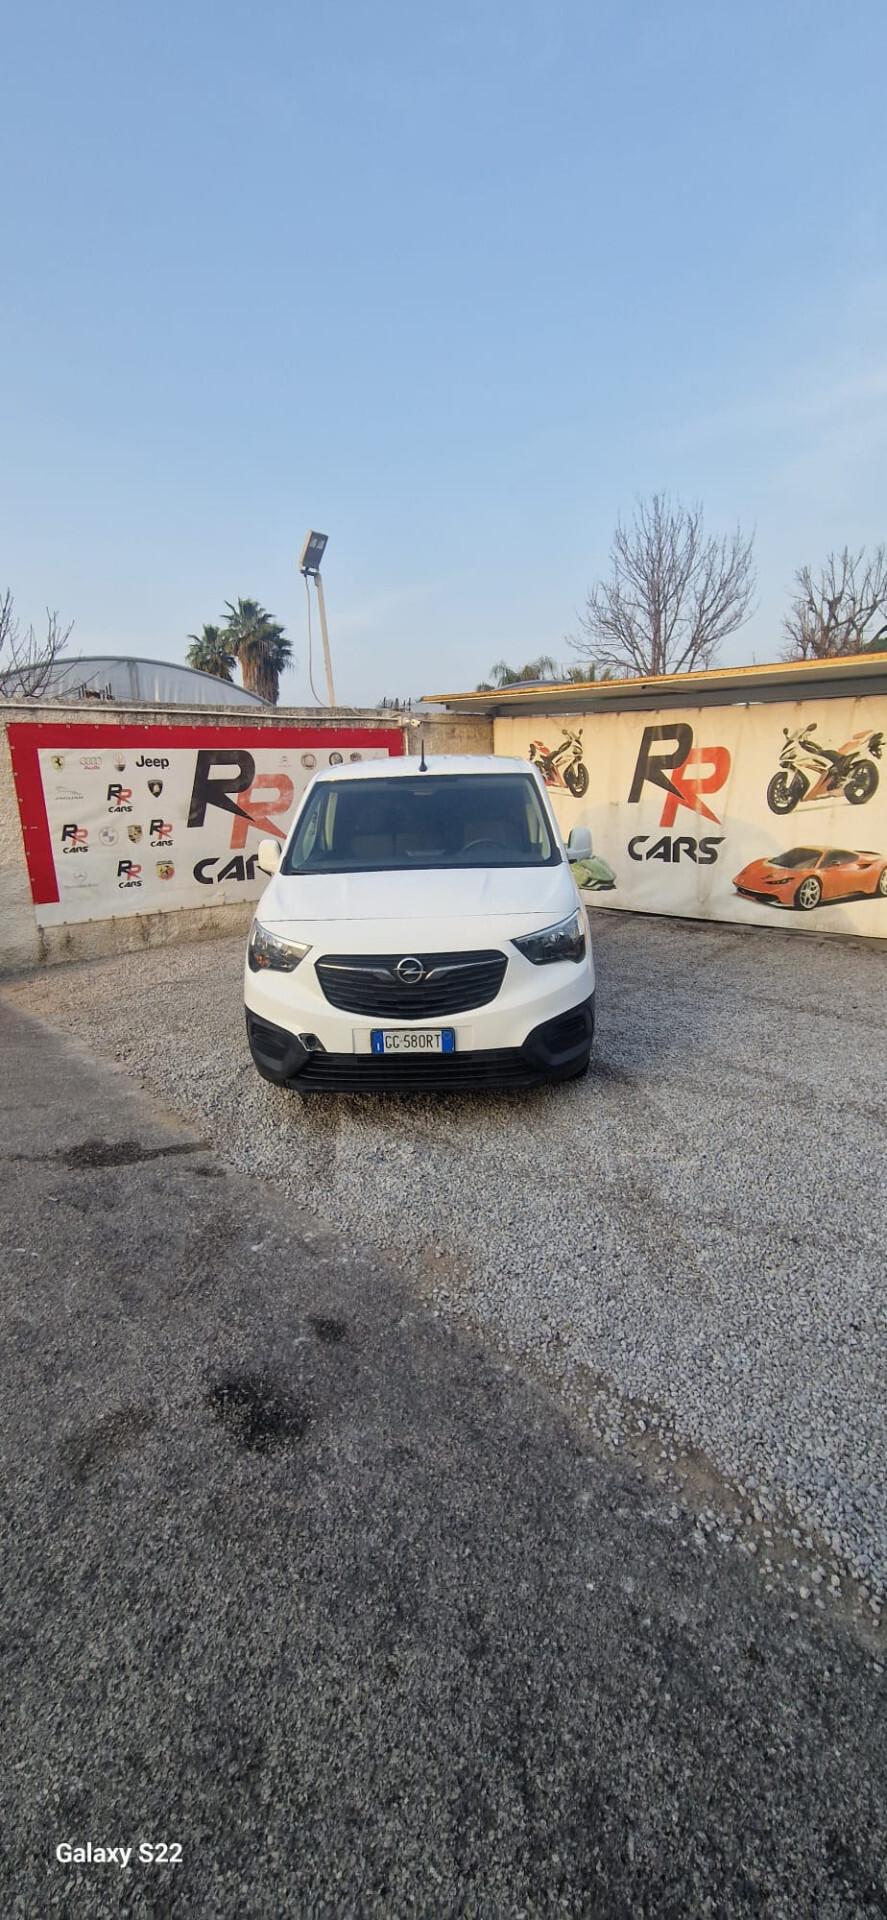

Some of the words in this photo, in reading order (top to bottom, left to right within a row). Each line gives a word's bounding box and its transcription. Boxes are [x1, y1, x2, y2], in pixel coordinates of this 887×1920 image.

[136, 755, 170, 770] Jeep
[151, 840, 173, 848] CARS
[63, 846, 88, 854] CARS
[628, 836, 726, 865] CARS
